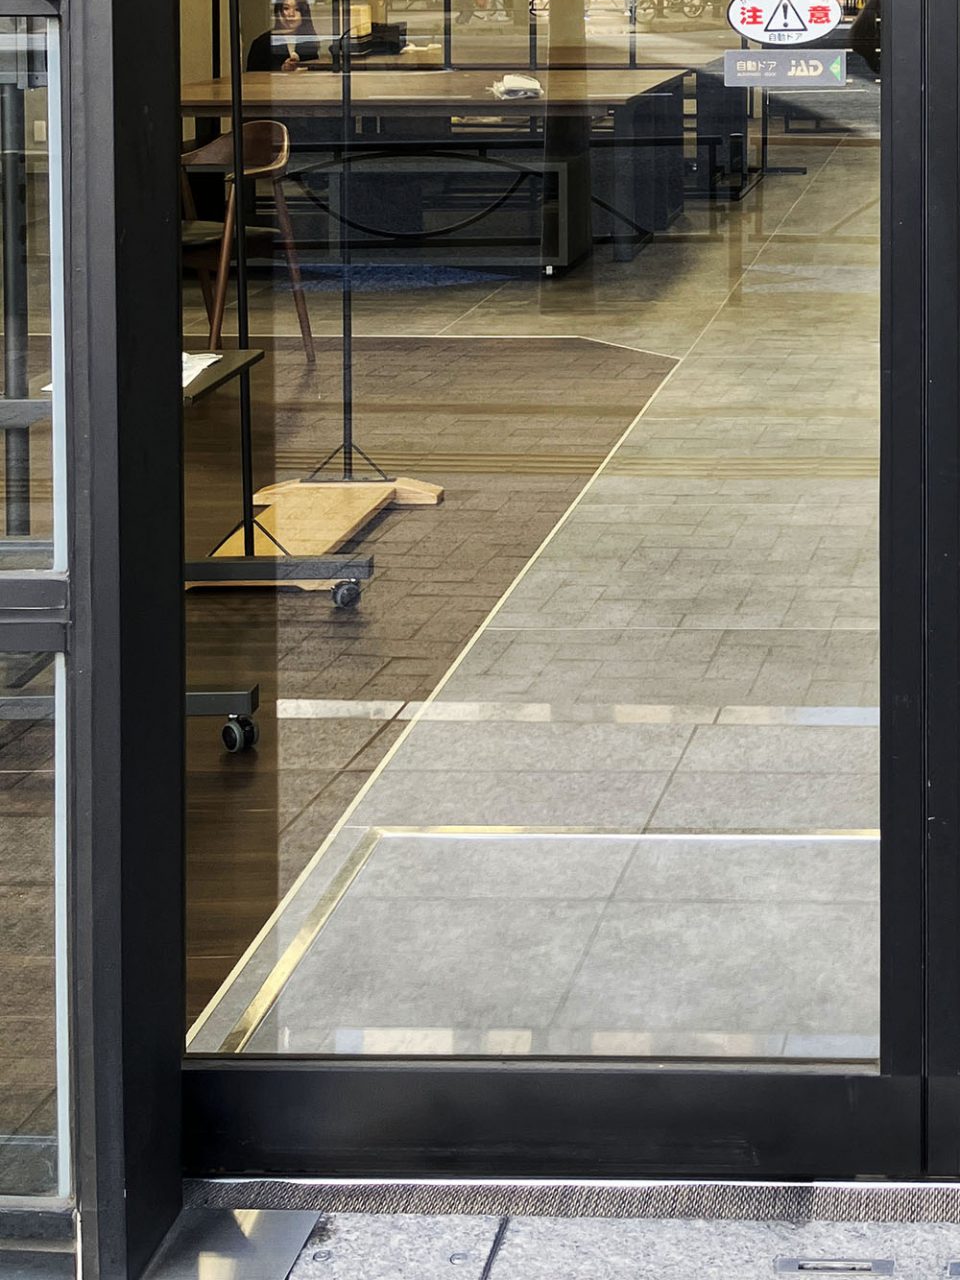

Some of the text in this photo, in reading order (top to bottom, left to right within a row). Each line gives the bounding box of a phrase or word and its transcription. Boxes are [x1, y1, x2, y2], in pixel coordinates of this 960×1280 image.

[768, 32, 803, 42] 自動ドア
[737, 60, 777, 72] 自動ドア
